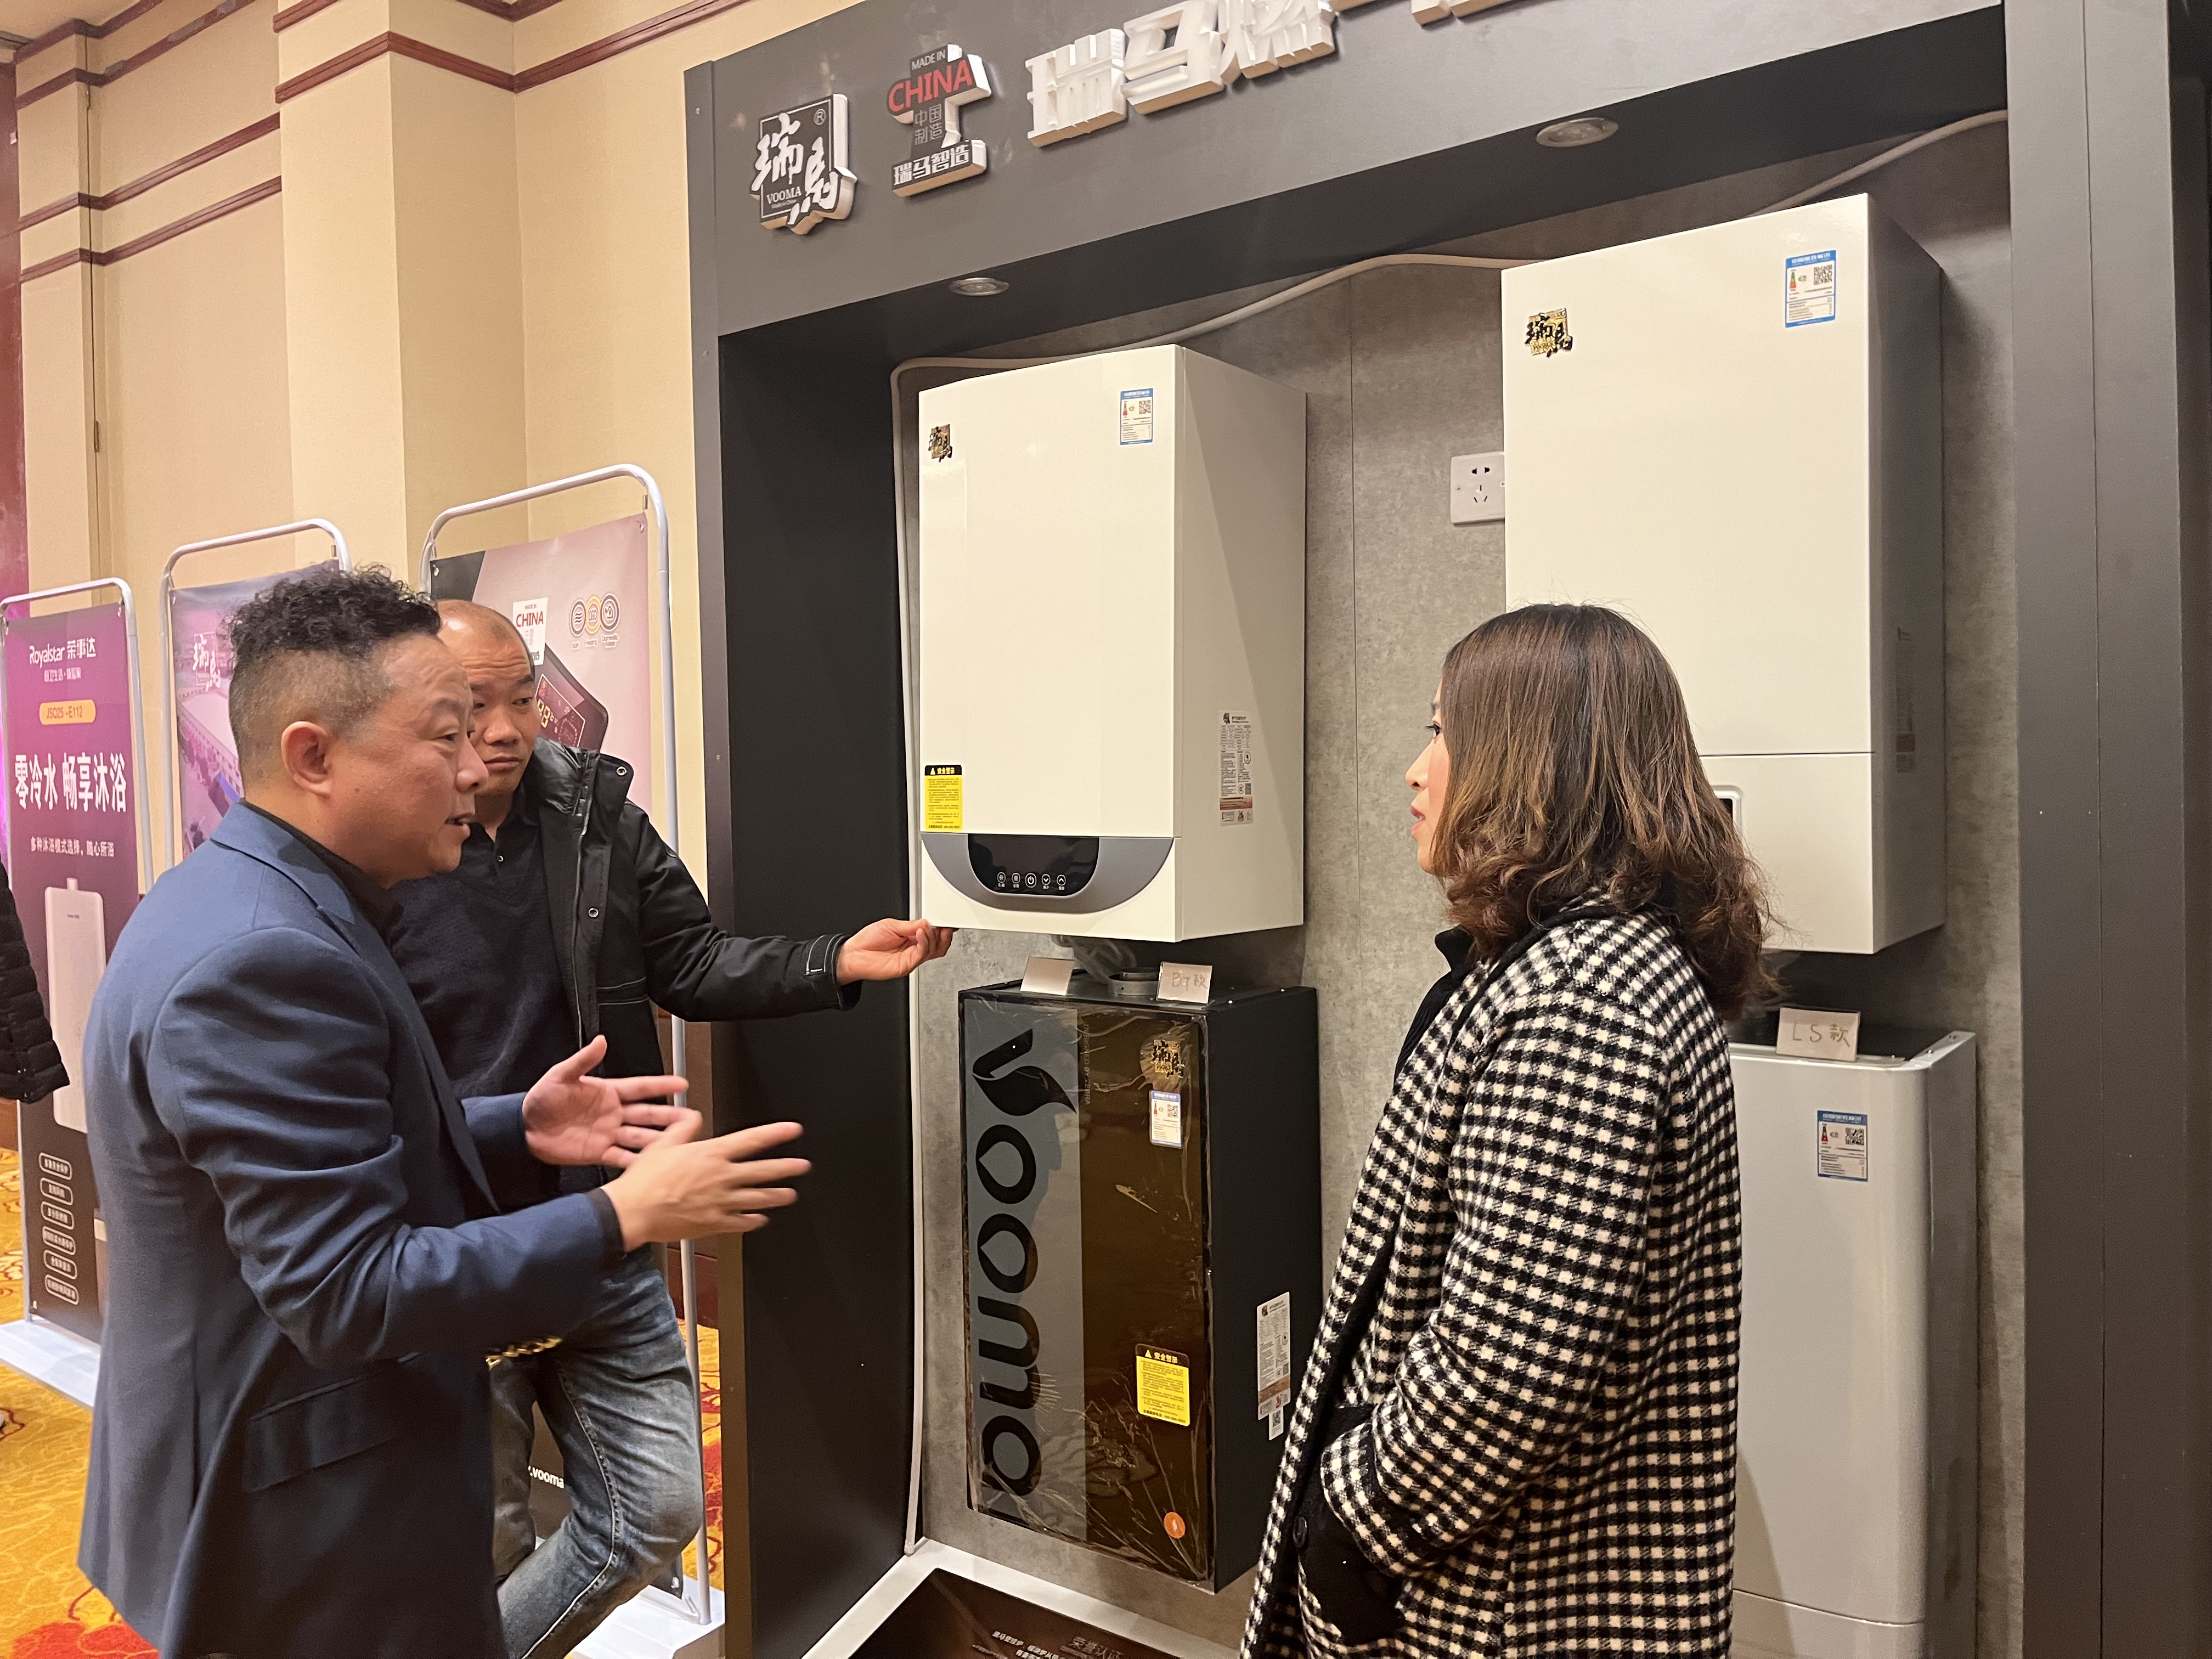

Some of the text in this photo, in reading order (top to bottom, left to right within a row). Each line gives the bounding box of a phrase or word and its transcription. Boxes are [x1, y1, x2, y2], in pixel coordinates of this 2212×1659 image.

[911, 49, 946, 70] MADE IN
[888, 59, 973, 112] CHINA
[915, 104, 942, 127] 中国
[914, 122, 943, 145] 制造
[893, 144, 969, 185] 瑞马智造
[766, 186, 802, 204] VOOMA
[516, 611, 544, 628] CHINA
[29, 636, 97, 668] Royalstar 荣事达
[15, 752, 127, 812] 零冷水 畅享沐浴
